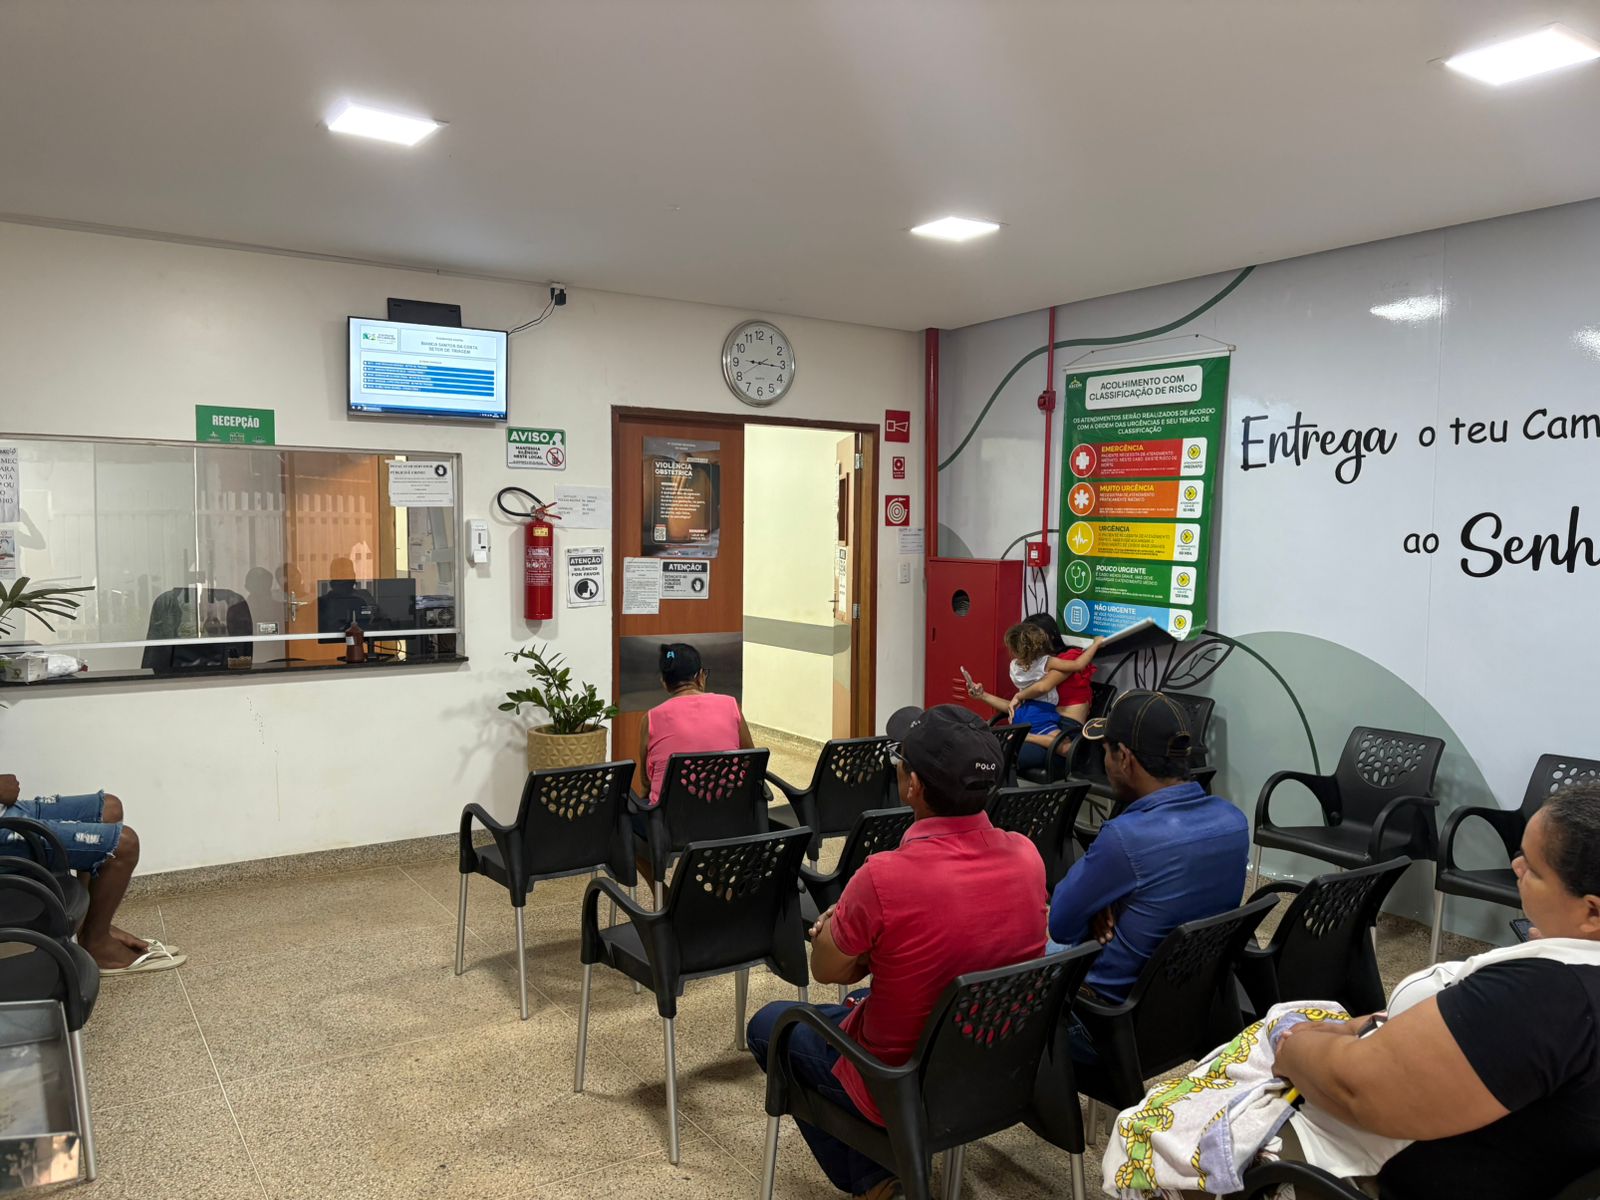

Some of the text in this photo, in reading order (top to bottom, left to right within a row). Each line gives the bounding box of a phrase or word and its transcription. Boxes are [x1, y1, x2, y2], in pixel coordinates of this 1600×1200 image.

[745, 334, 752, 343] 11
[755, 330, 764, 340] 12
[769, 336, 773, 344] 1
[736, 343, 745, 353] 10
[776, 346, 782, 356] 2
[733, 357, 739, 367] 9
[780, 360, 785, 369] 3
[736, 372, 742, 381] 8
[777, 374, 783, 383] 4
[746, 382, 751, 392] 7
[1100, 375, 1185, 390] ACOLHIMENTO COM
[757, 387, 763, 396] 6
[768, 384, 774, 393] 5
[1089, 384, 1197, 401] CLASSIFICAÇÃO DE RISCO
[1080, 415, 1121, 423] ATENDIMENTOS
[1122, 412, 1141, 420] SERÃO
[1142, 410, 1178, 419] REALIZADOS
[212, 415, 260, 429] RECEPÇÃO
[1127, 419, 1160, 427] URGÊNCIAS
[1118, 426, 1162, 435] CLASSIFICAÇÃO
[510, 431, 550, 442] AVISO
[1101, 444, 1144, 453] EMERGÊNCIA
[1240, 411, 1398, 484] Entrega
[1419, 426, 1436, 447] o
[1450, 418, 1508, 445] teu
[655, 461, 692, 470] VIOLÊNCIA
[1122, 484, 1154, 492] URGÊNCIA
[1403, 506, 1600, 578] ao Senh
[570, 556, 601, 565] ATENÇÃO
[668, 563, 702, 572] ATENÇÃO!
[1118, 566, 1146, 574] URGENTE
[1094, 603, 1136, 614] NÃO URGENTE
